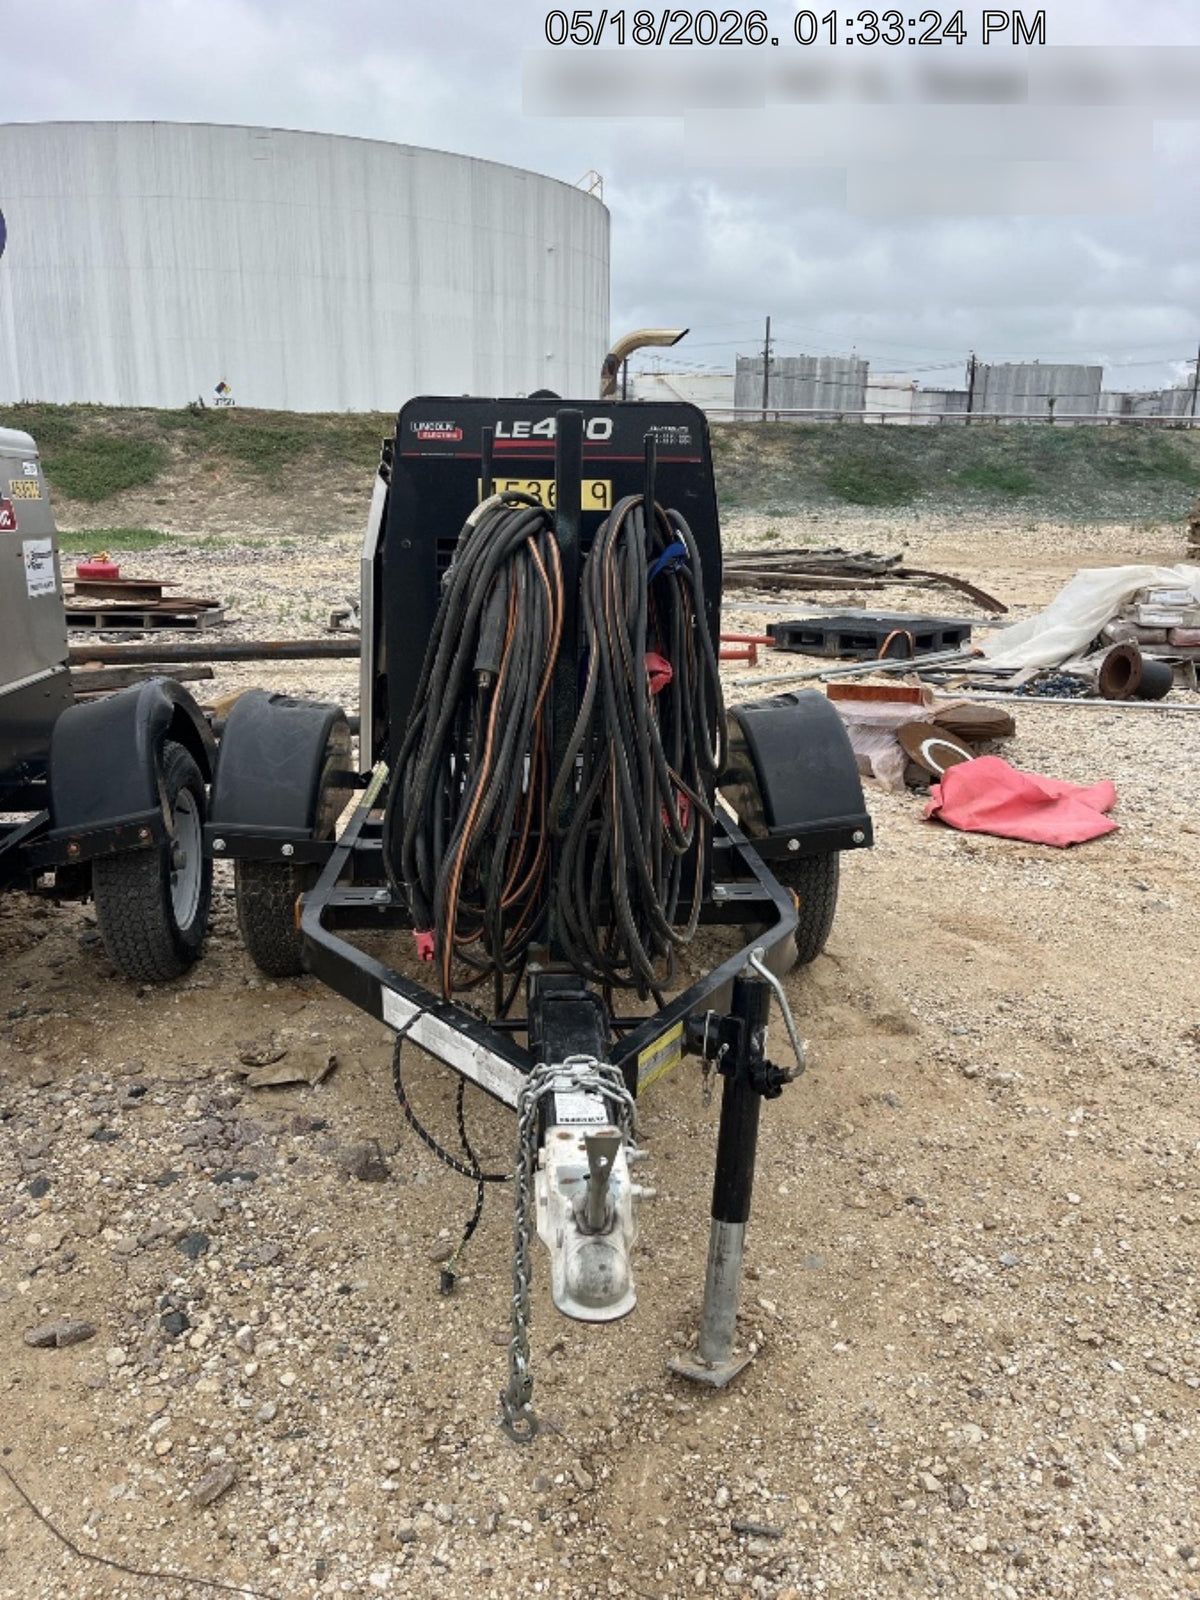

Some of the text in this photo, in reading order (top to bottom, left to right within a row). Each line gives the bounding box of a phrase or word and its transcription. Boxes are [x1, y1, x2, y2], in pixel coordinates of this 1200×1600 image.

[413, 421, 454, 431] LINCOLN
[495, 417, 614, 440] LE40
[422, 431, 458, 439] ELECTRIC
